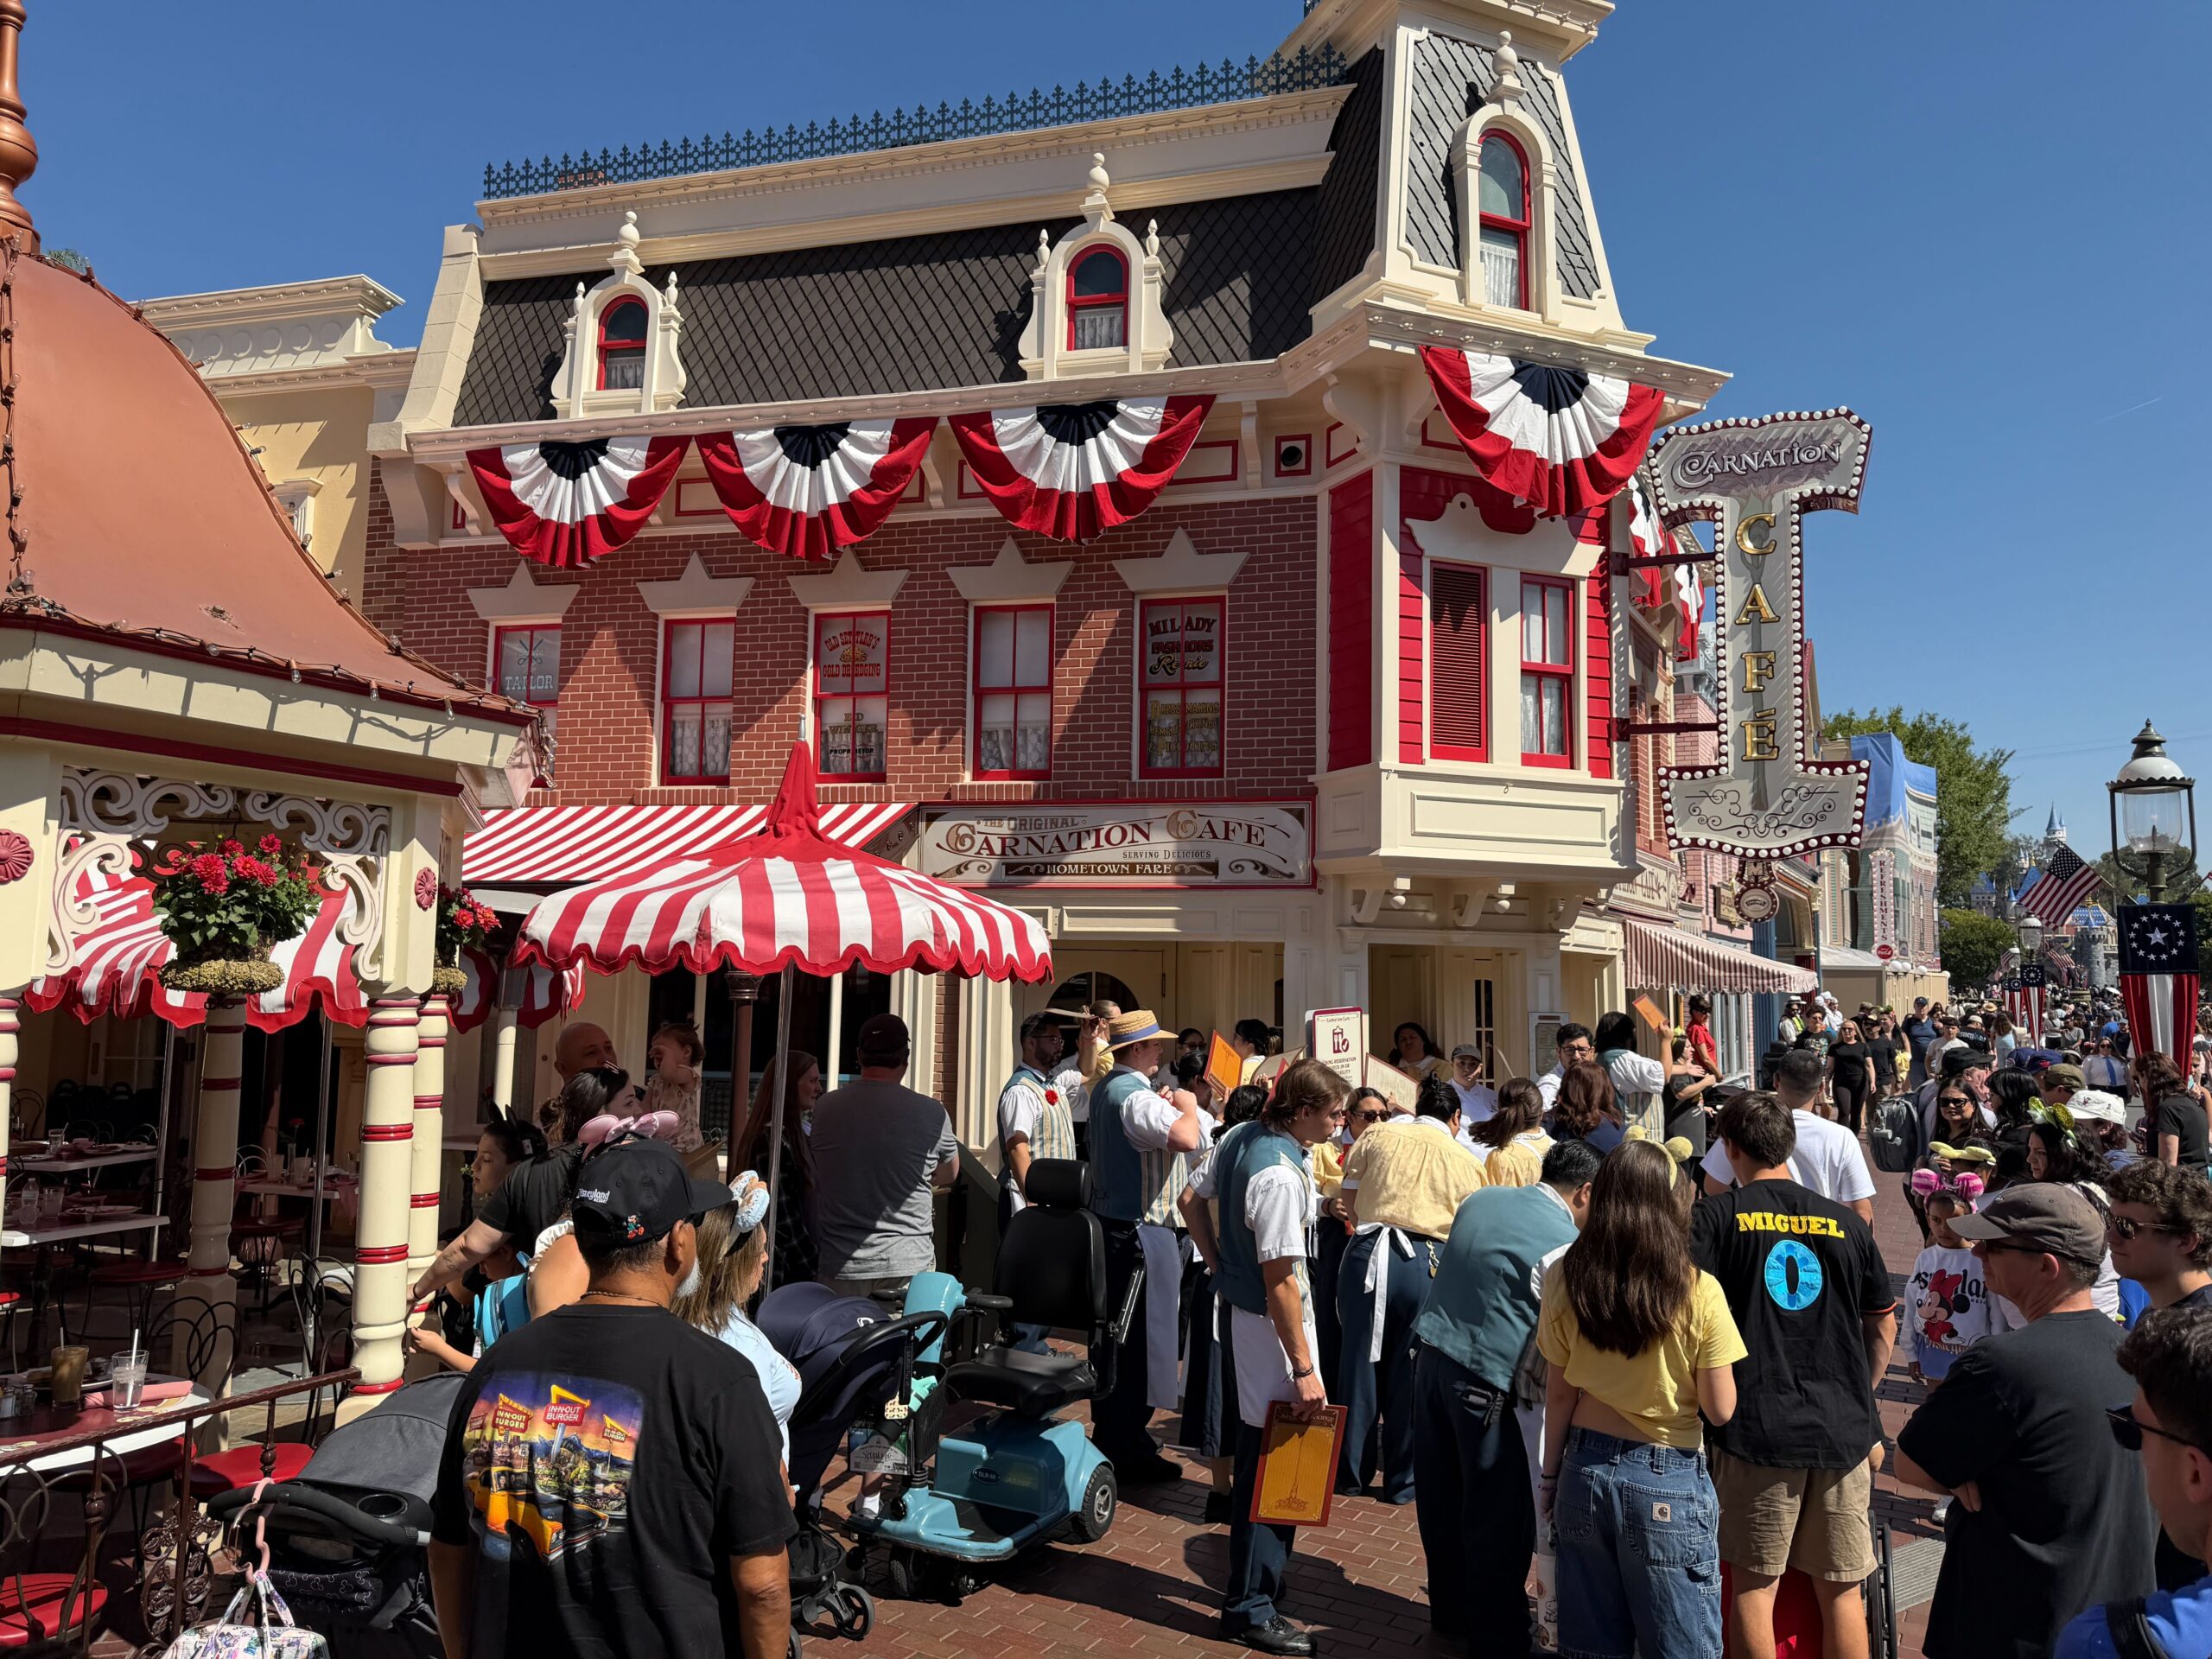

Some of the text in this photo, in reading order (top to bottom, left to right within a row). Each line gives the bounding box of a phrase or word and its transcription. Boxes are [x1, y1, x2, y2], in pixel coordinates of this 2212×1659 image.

[1672, 442, 1840, 488] CARNATION
[1148, 616, 1217, 637] MILADY
[824, 636, 839, 652] OLD
[1735, 512, 1780, 762] CAFÉ
[823, 663, 880, 677] GOLD DREDGING
[505, 675, 553, 690] TAILOR
[982, 817, 1078, 831] THE ORIGINAL
[945, 822, 1151, 858] CARNATION
[1123, 849, 1211, 860] SERVING DELICIOUS
[1046, 863, 1172, 875] HOMETOWN FARE
[1878, 860, 1888, 941] REFRESHMENTS
[1736, 1212, 1845, 1239] MIGUEL
[1764, 1239, 1822, 1311] 0
[494, 1417, 525, 1429] BURGER
[546, 1413, 579, 1421] BURGER
